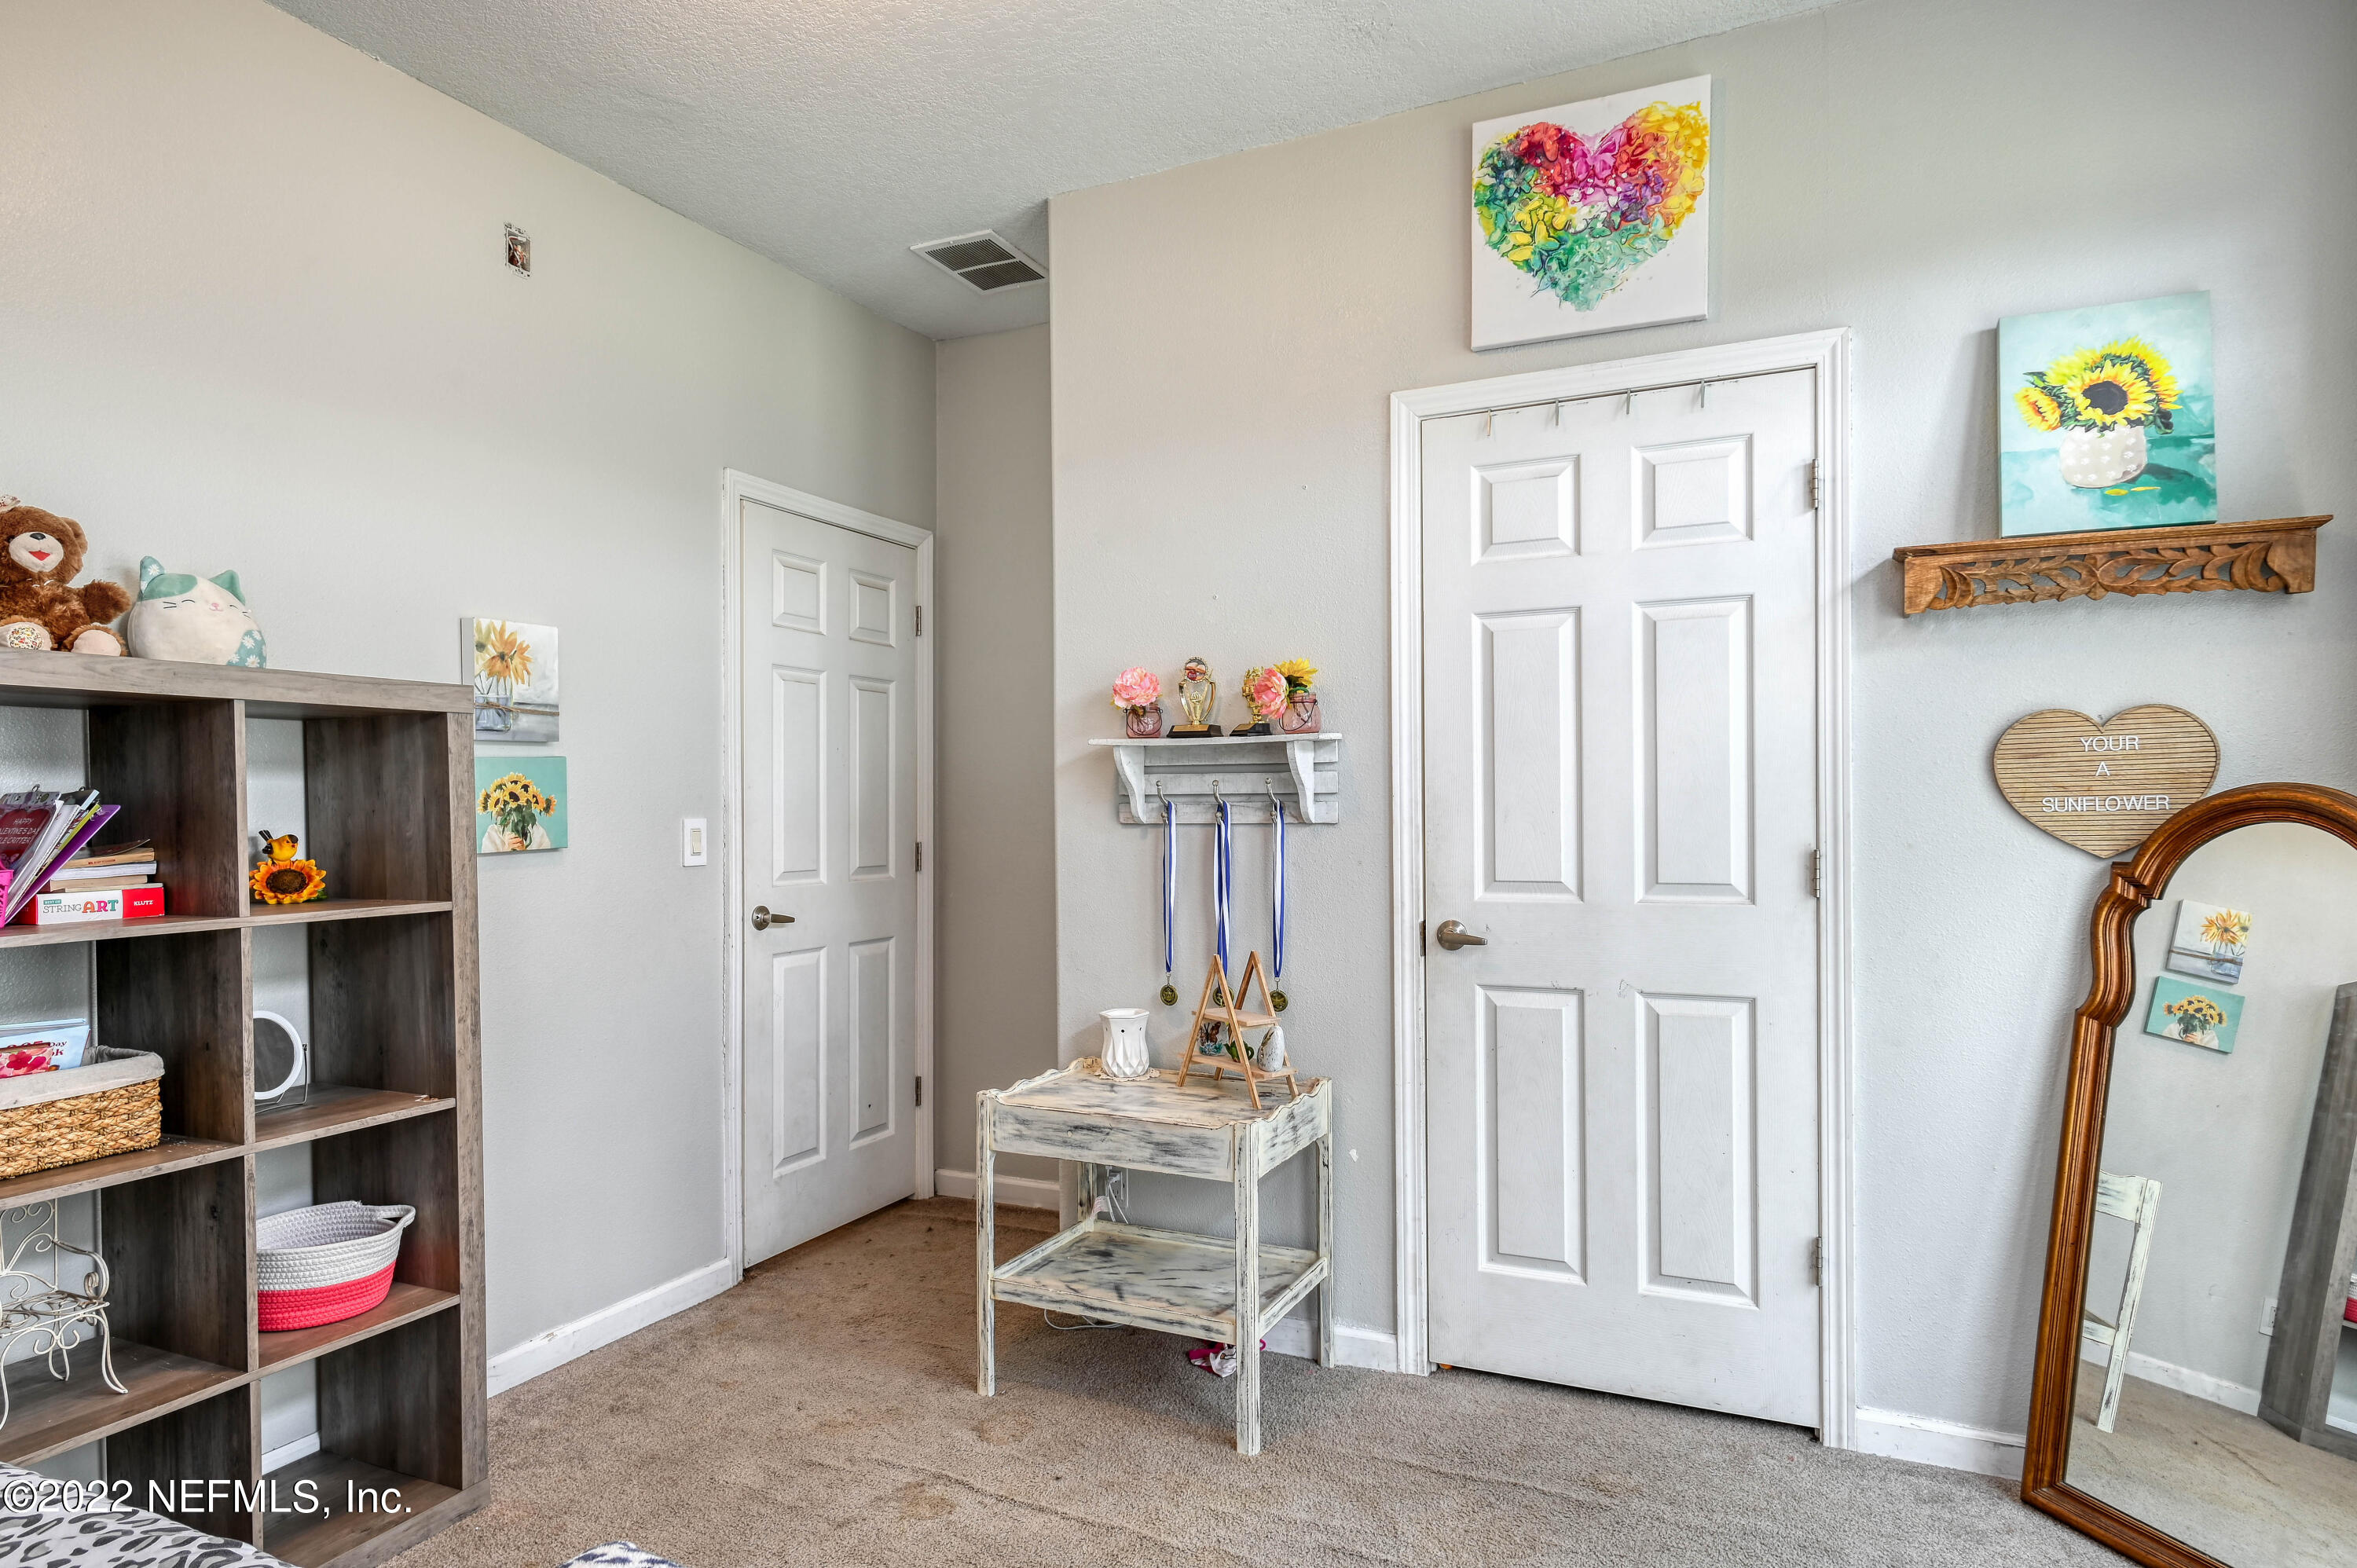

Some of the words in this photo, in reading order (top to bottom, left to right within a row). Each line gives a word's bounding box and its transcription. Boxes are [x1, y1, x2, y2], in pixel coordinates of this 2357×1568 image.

[2080, 735, 2139, 752] YOUR
[2095, 761, 2110, 777] A
[2042, 795, 2170, 812] SUNFLOWER
[42, 904, 82, 914] STRING
[82, 899, 119, 914] ART
